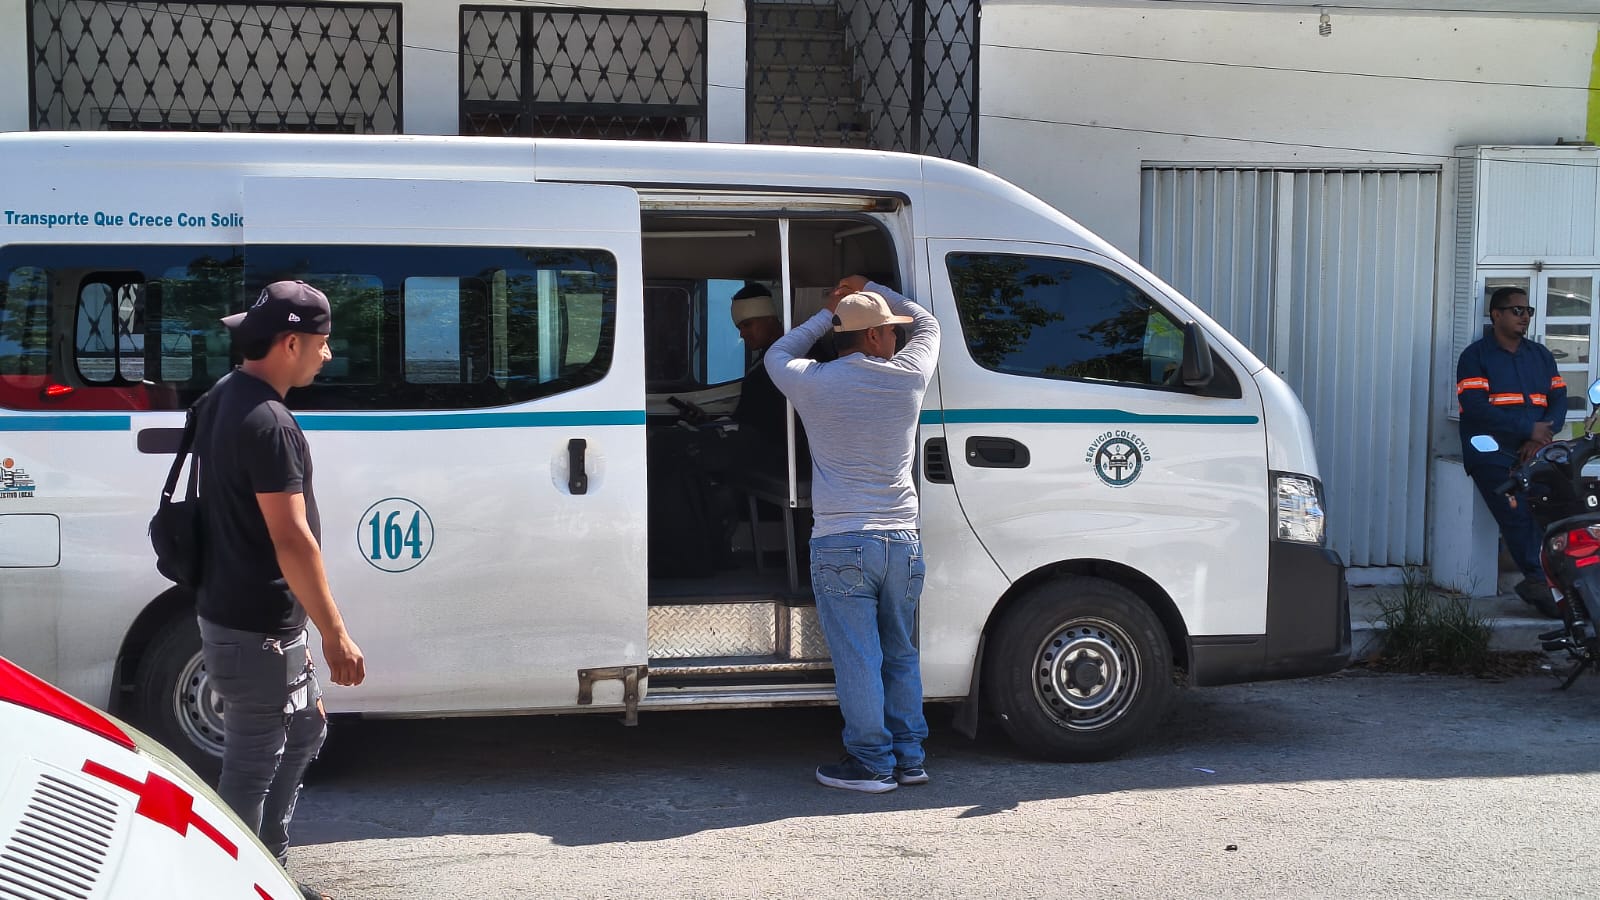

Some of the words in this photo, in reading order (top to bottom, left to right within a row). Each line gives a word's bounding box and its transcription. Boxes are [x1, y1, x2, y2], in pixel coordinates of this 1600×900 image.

[4, 210, 89, 228] Transporte
[94, 211, 124, 226] Que
[128, 212, 173, 227] Crece
[177, 212, 206, 227] Con
[1085, 431, 1113, 463] SERVICIO
[1115, 430, 1151, 462] COLECTIVO
[368, 510, 423, 560] 164
